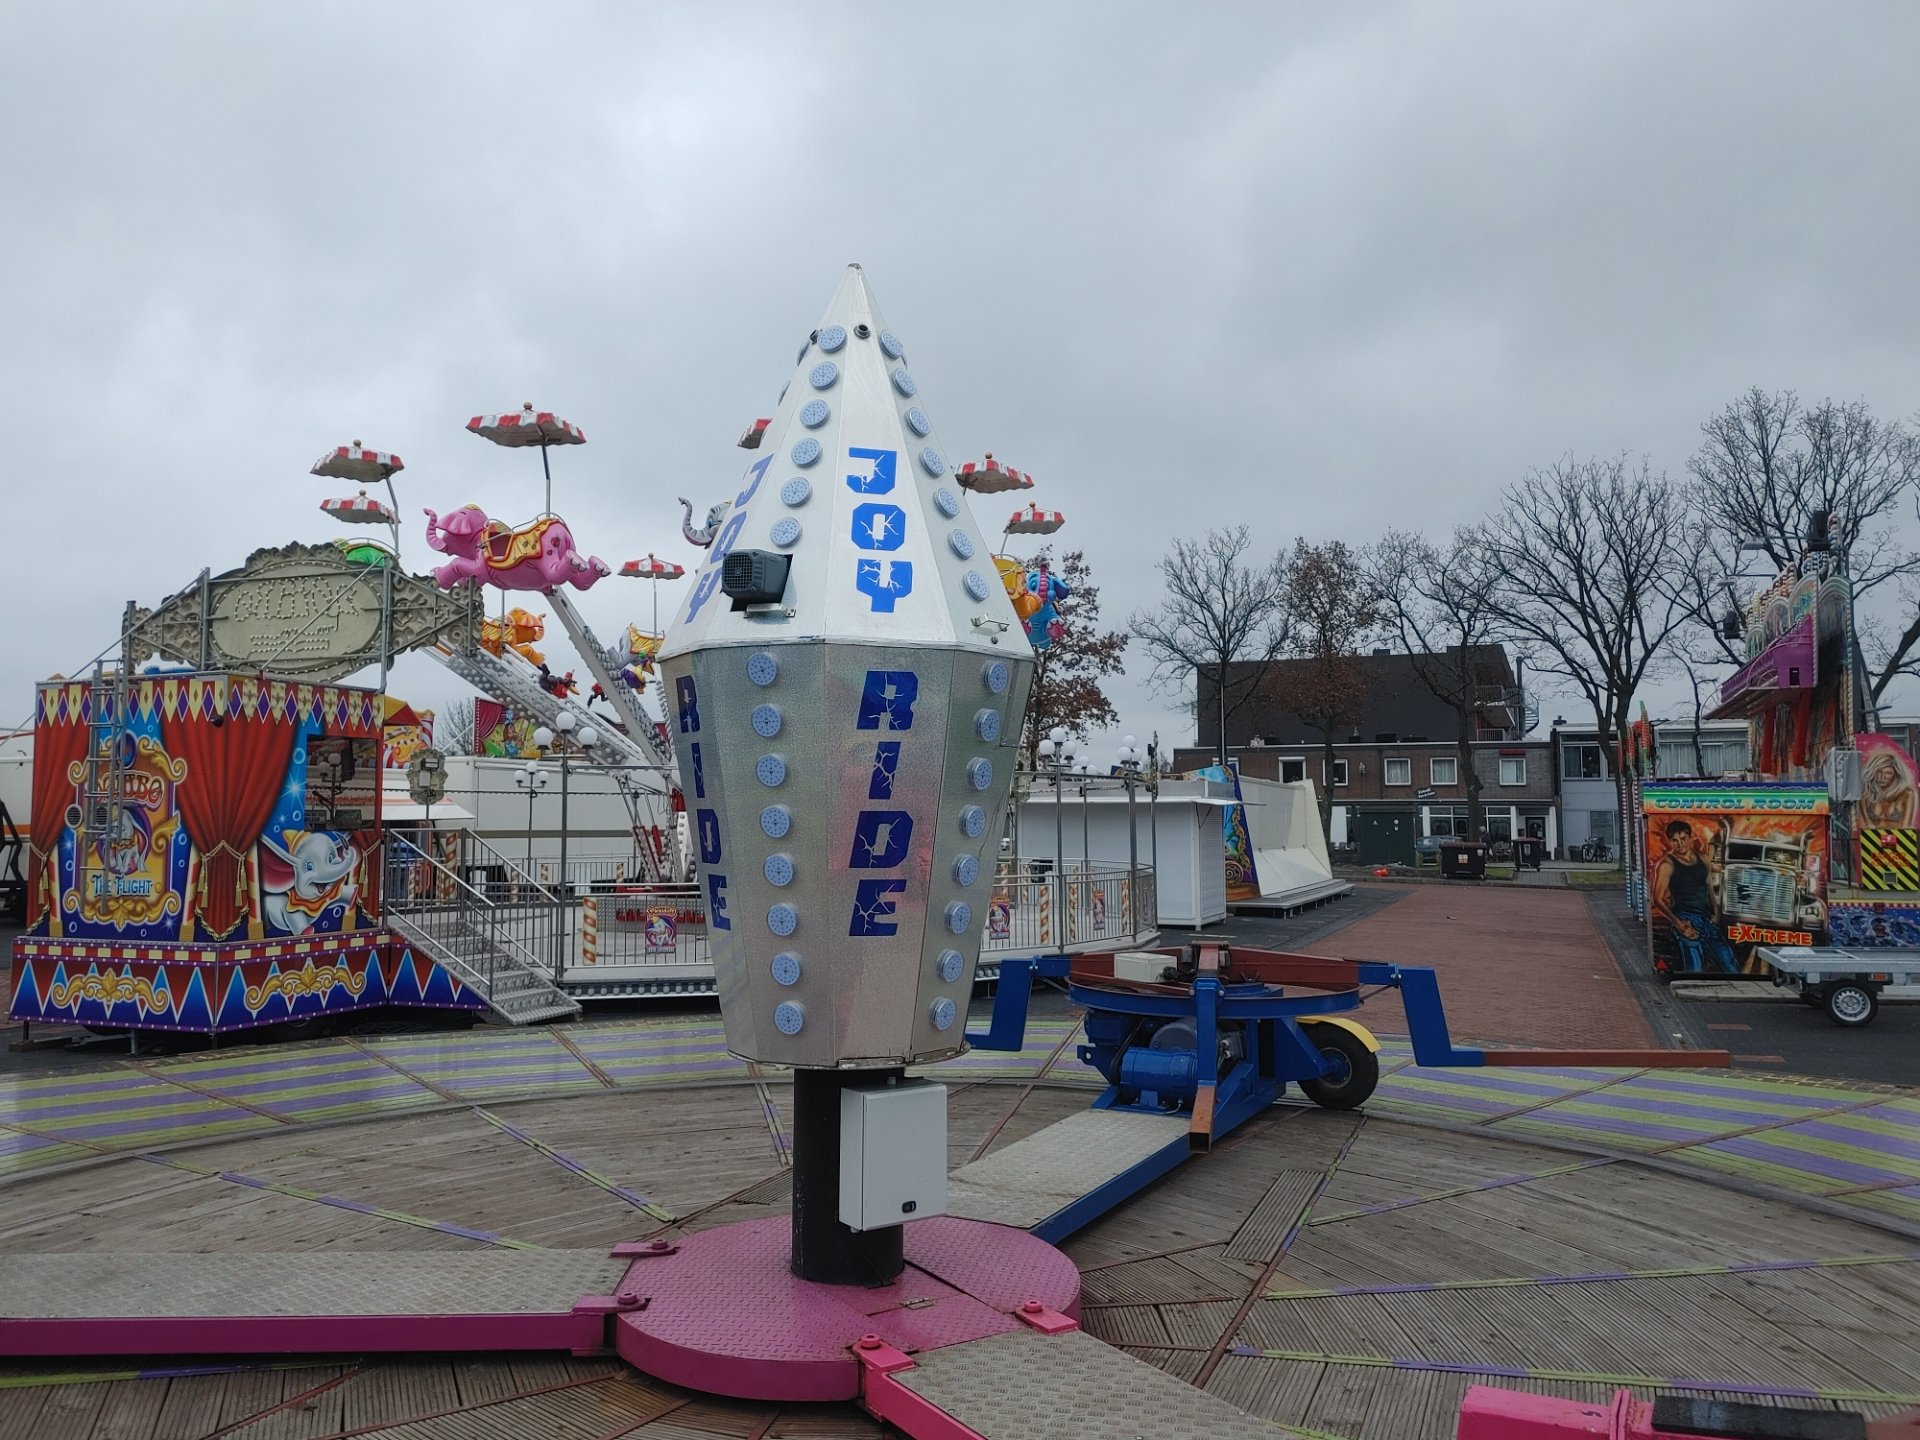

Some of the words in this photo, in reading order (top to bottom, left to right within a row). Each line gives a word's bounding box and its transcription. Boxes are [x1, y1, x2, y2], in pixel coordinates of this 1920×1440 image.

[684, 453, 774, 625] JOY
[846, 446, 913, 613] JOY
[114, 874, 153, 897] FLIGHT
[675, 675, 731, 931] RIDE
[849, 670, 919, 937] RIDE
[1654, 798, 1745, 810] CONTROL
[1751, 798, 1815, 810] ROOM
[1728, 923, 1812, 945] EXTREME
